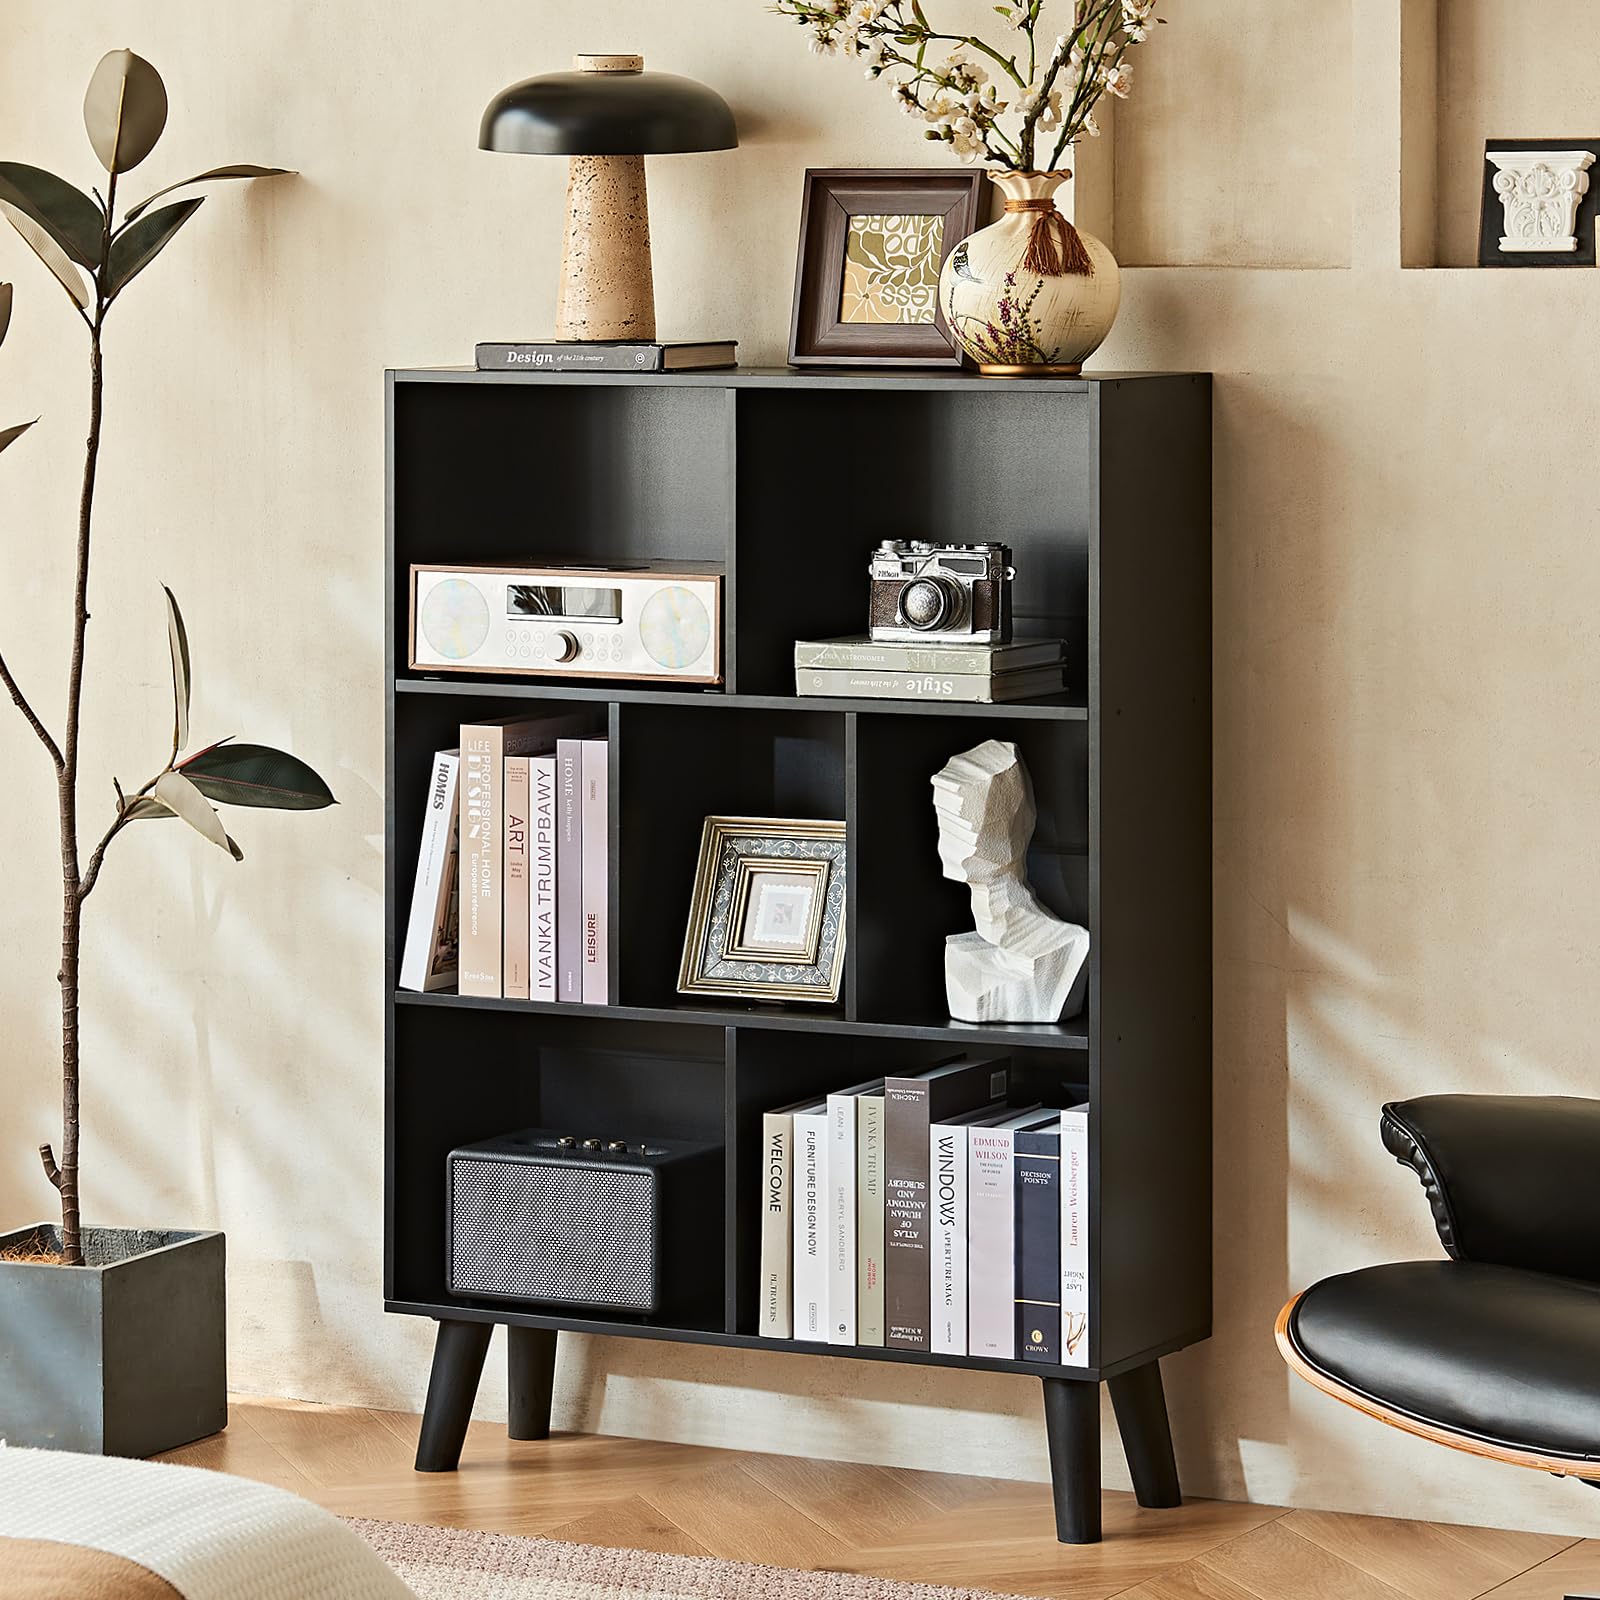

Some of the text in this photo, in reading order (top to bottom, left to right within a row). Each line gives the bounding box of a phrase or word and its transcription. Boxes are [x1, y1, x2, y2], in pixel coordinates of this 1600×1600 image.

[885, 234, 920, 255] DO
[507, 351, 553, 366] Design
[556, 355, 563, 363] of
[906, 677, 953, 695] Style
[467, 740, 491, 753] LIFE
[433, 762, 450, 811] HOMES
[564, 758, 574, 796] HOME
[467, 754, 481, 839] DESIGN
[481, 755, 491, 897] PROFESSIONAL HOME
[509, 814, 524, 855] ART
[537, 768, 552, 988] IVANKA TRUMPBAWY
[471, 852, 479, 936] European reference
[587, 913, 596, 963] LEISURE
[891, 1094, 920, 1102] TASCHEN
[867, 1106, 877, 1195] IVANKA TRUMP
[973, 1137, 1010, 1148] EDMUND
[975, 1151, 1008, 1160] WILSON
[769, 1133, 783, 1213] WELCOME
[938, 1136, 955, 1226] WINDOWS
[1020, 1170, 1052, 1179] DECISION
[1023, 1177, 1049, 1185] POINTS
[806, 1130, 817, 1256] FURNITURE DESIGN NOW
[896, 1190, 916, 1199] AND
[1069, 1151, 1080, 1247] Lauren Weisberger
[886, 1199, 927, 1209] ANATOMY
[890, 1210, 922, 1219] HUMAN
[893, 1229, 919, 1239] ATLAS
[900, 1220, 912, 1229] OF
[838, 1224, 846, 1272] SANDBERG
[1066, 1283, 1082, 1292] LAST
[1025, 1345, 1049, 1353] CROWN
